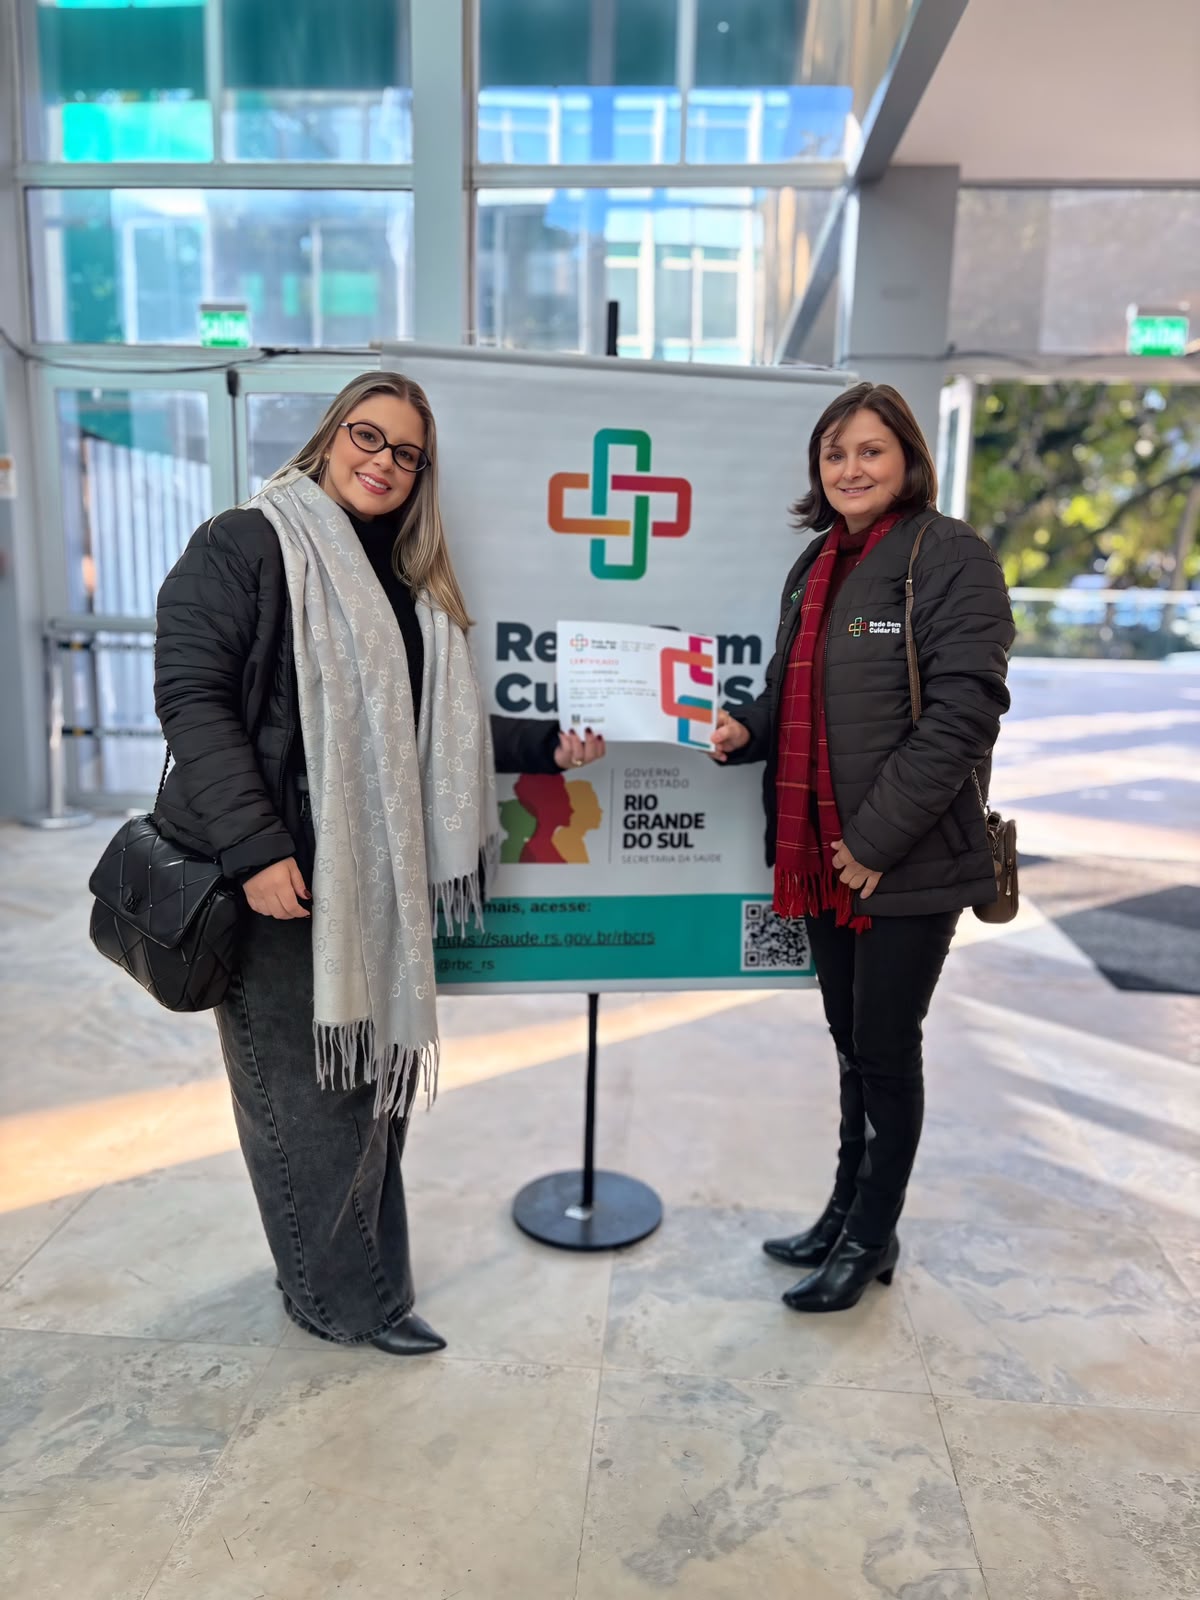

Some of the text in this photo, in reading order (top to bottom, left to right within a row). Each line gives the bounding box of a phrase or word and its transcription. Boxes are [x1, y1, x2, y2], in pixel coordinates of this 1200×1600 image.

[496, 622, 557, 662] Re
[624, 768, 680, 777] GOVERNO
[624, 779, 689, 788] DO ESTADO
[624, 794, 658, 811] RIO
[623, 812, 705, 830] GRANDE
[623, 832, 694, 849] DO SUL
[622, 855, 675, 864] SECRETARIA
[678, 855, 690, 863] DA
[530, 899, 591, 913] acesse:
